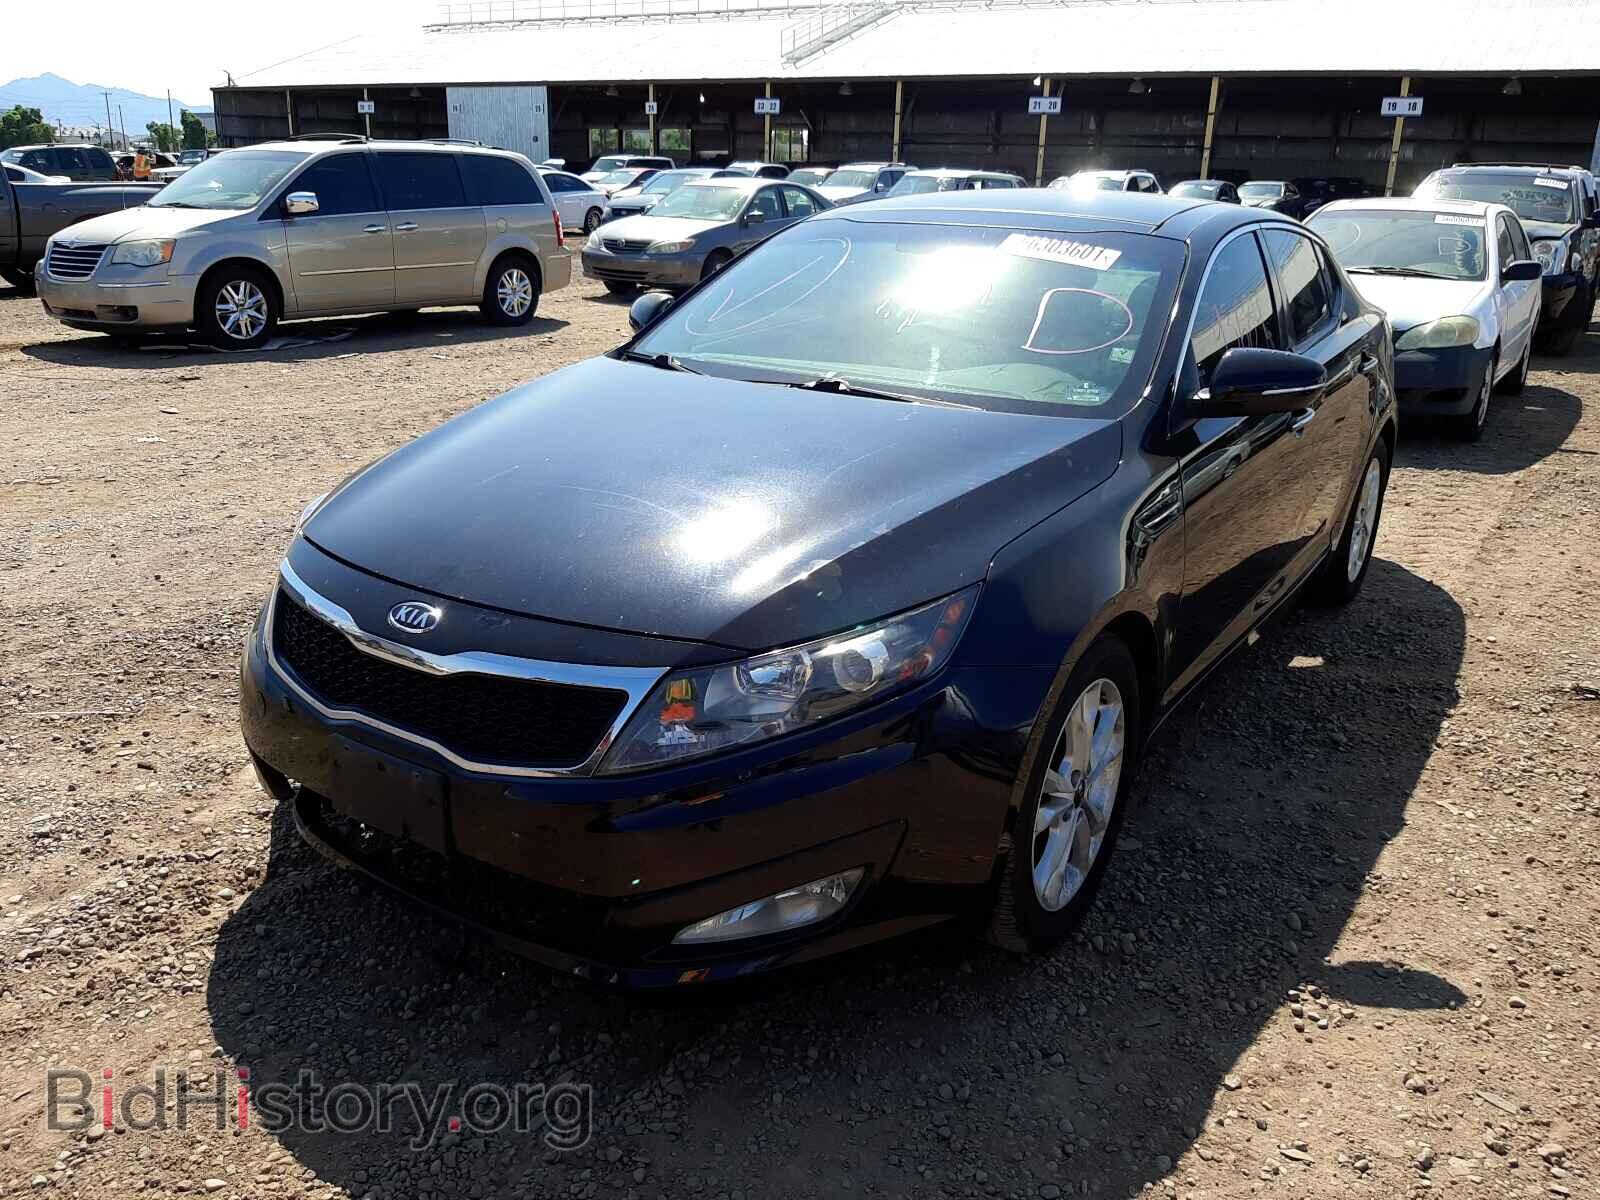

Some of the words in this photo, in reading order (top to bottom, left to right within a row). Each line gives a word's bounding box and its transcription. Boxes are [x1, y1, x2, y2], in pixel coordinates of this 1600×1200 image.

[1032, 100, 1040, 110] 21
[1048, 100, 1057, 110] 20
[1387, 101, 1397, 111] 19
[394, 605, 430, 628] KIA
